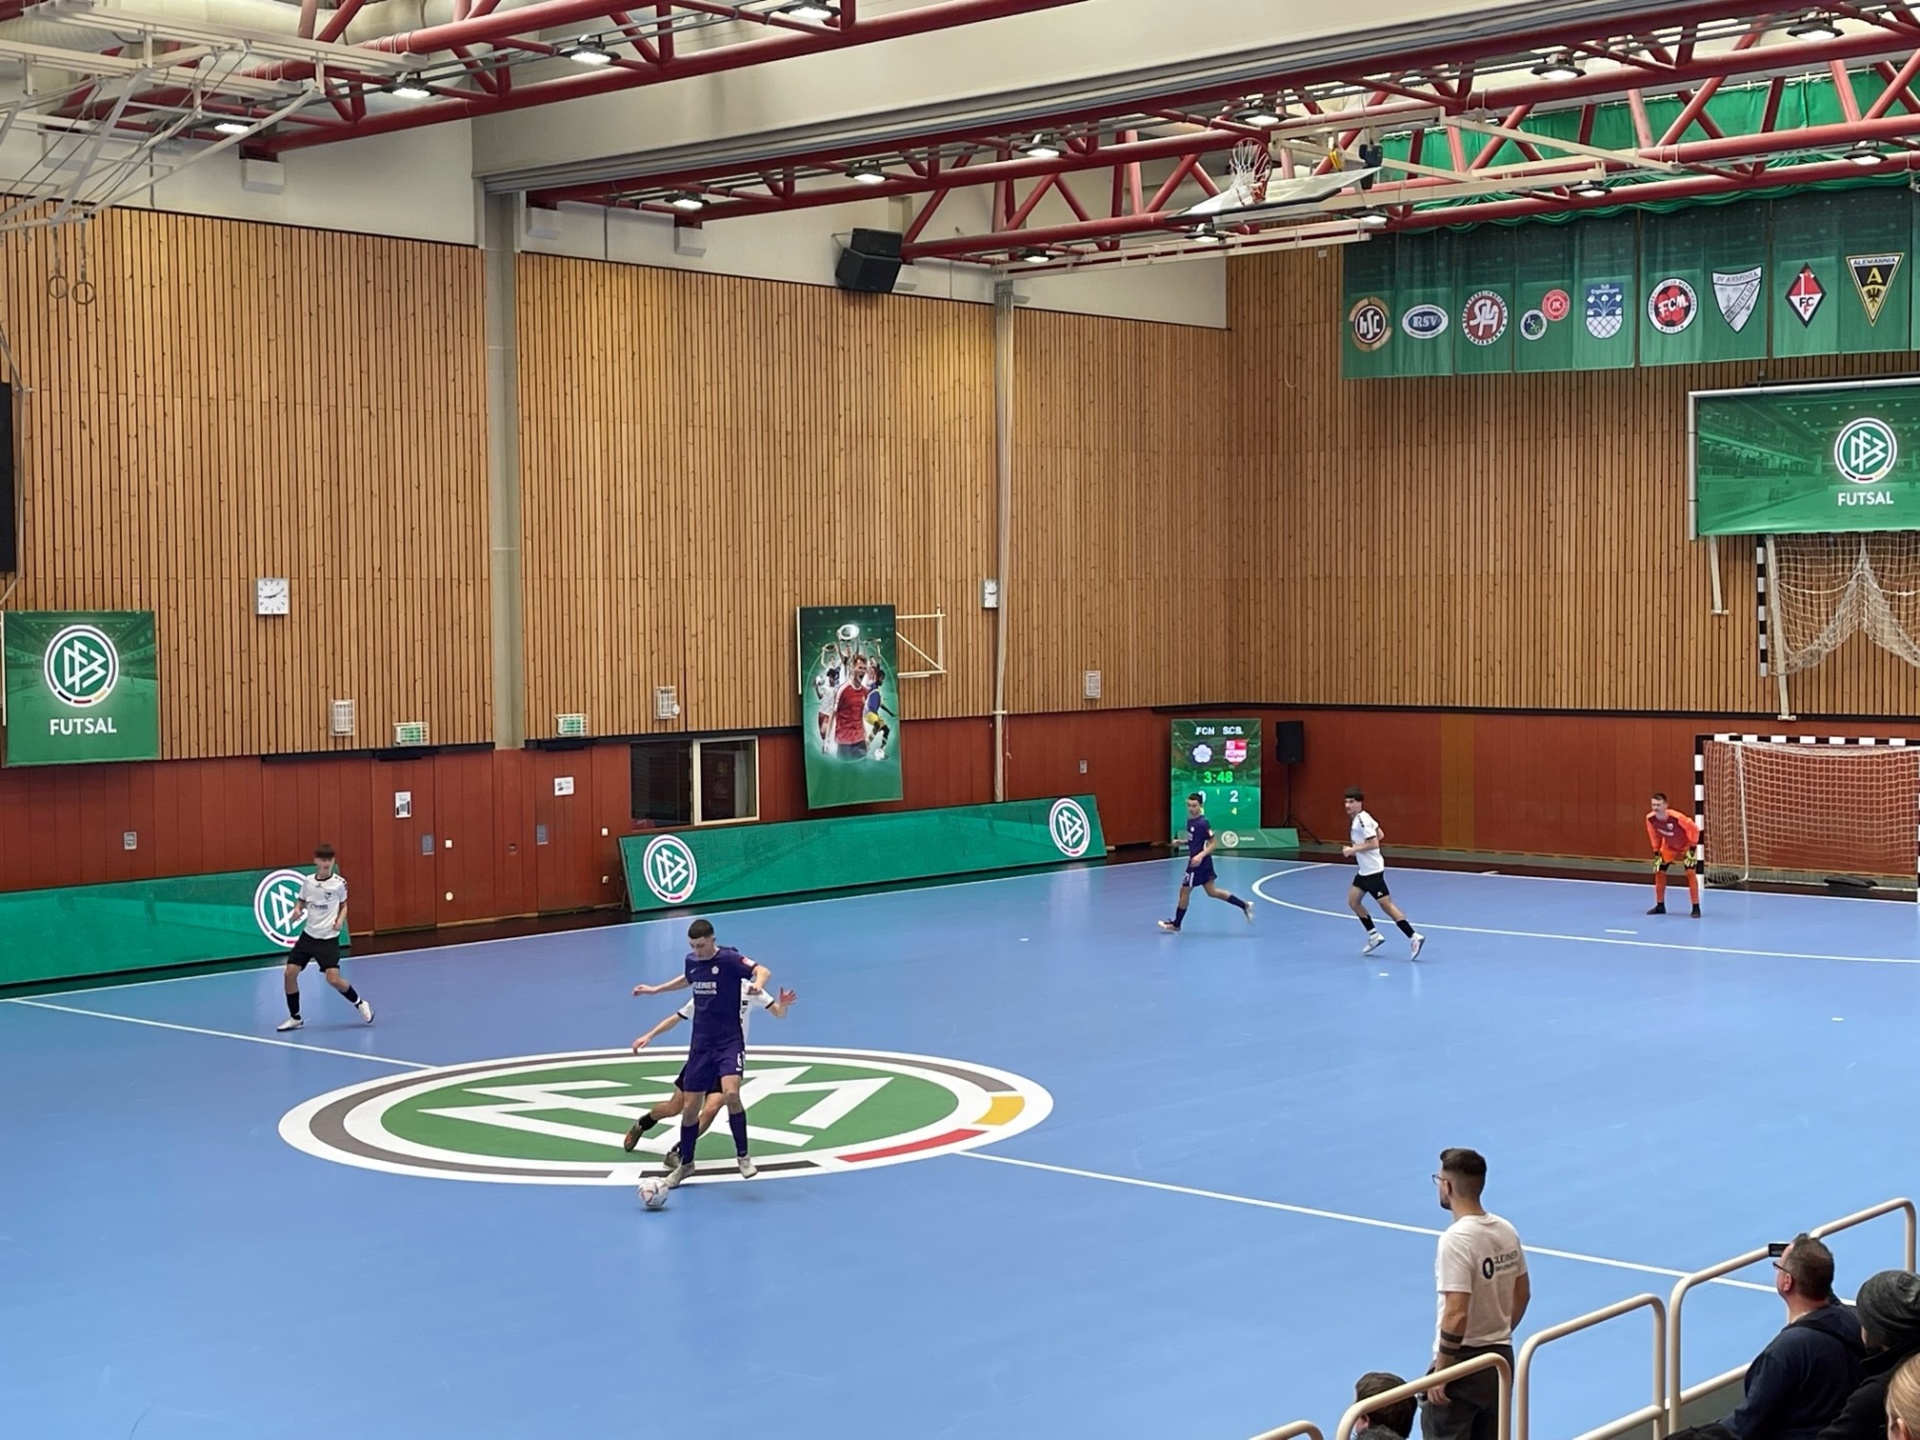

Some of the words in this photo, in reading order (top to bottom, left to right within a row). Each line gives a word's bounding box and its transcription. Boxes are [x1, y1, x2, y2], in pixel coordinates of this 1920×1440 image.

[1853, 257, 1896, 265] ALEMANNIA
[1867, 267, 1882, 284] A
[1412, 315, 1438, 328] RSV
[1837, 491, 1894, 506] FUTSAL
[50, 717, 117, 736] FUTSAL
[1203, 771, 1233, 784] 3:48
[1230, 790, 1239, 802] 2
